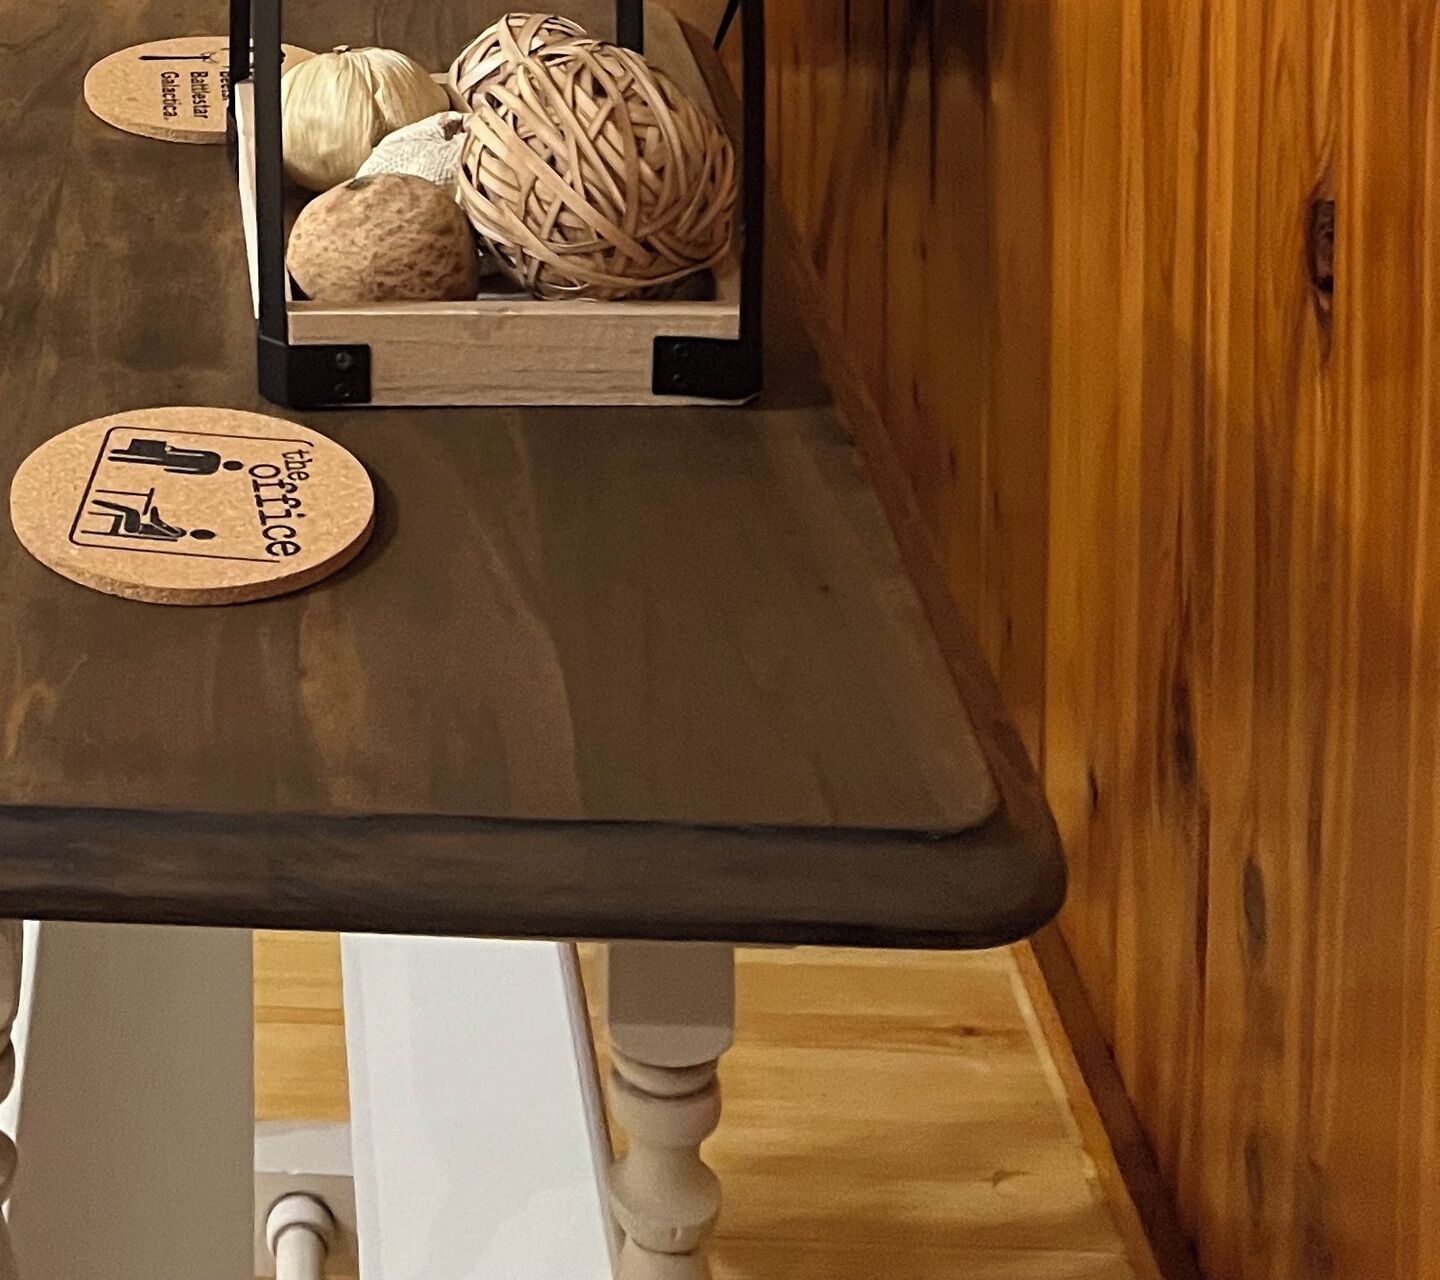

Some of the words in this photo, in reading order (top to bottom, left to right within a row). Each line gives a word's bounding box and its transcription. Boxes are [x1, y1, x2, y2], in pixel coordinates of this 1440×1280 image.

[190, 71, 211, 119] Battlestar
[281, 449, 313, 481] the
[248, 463, 306, 557] office
